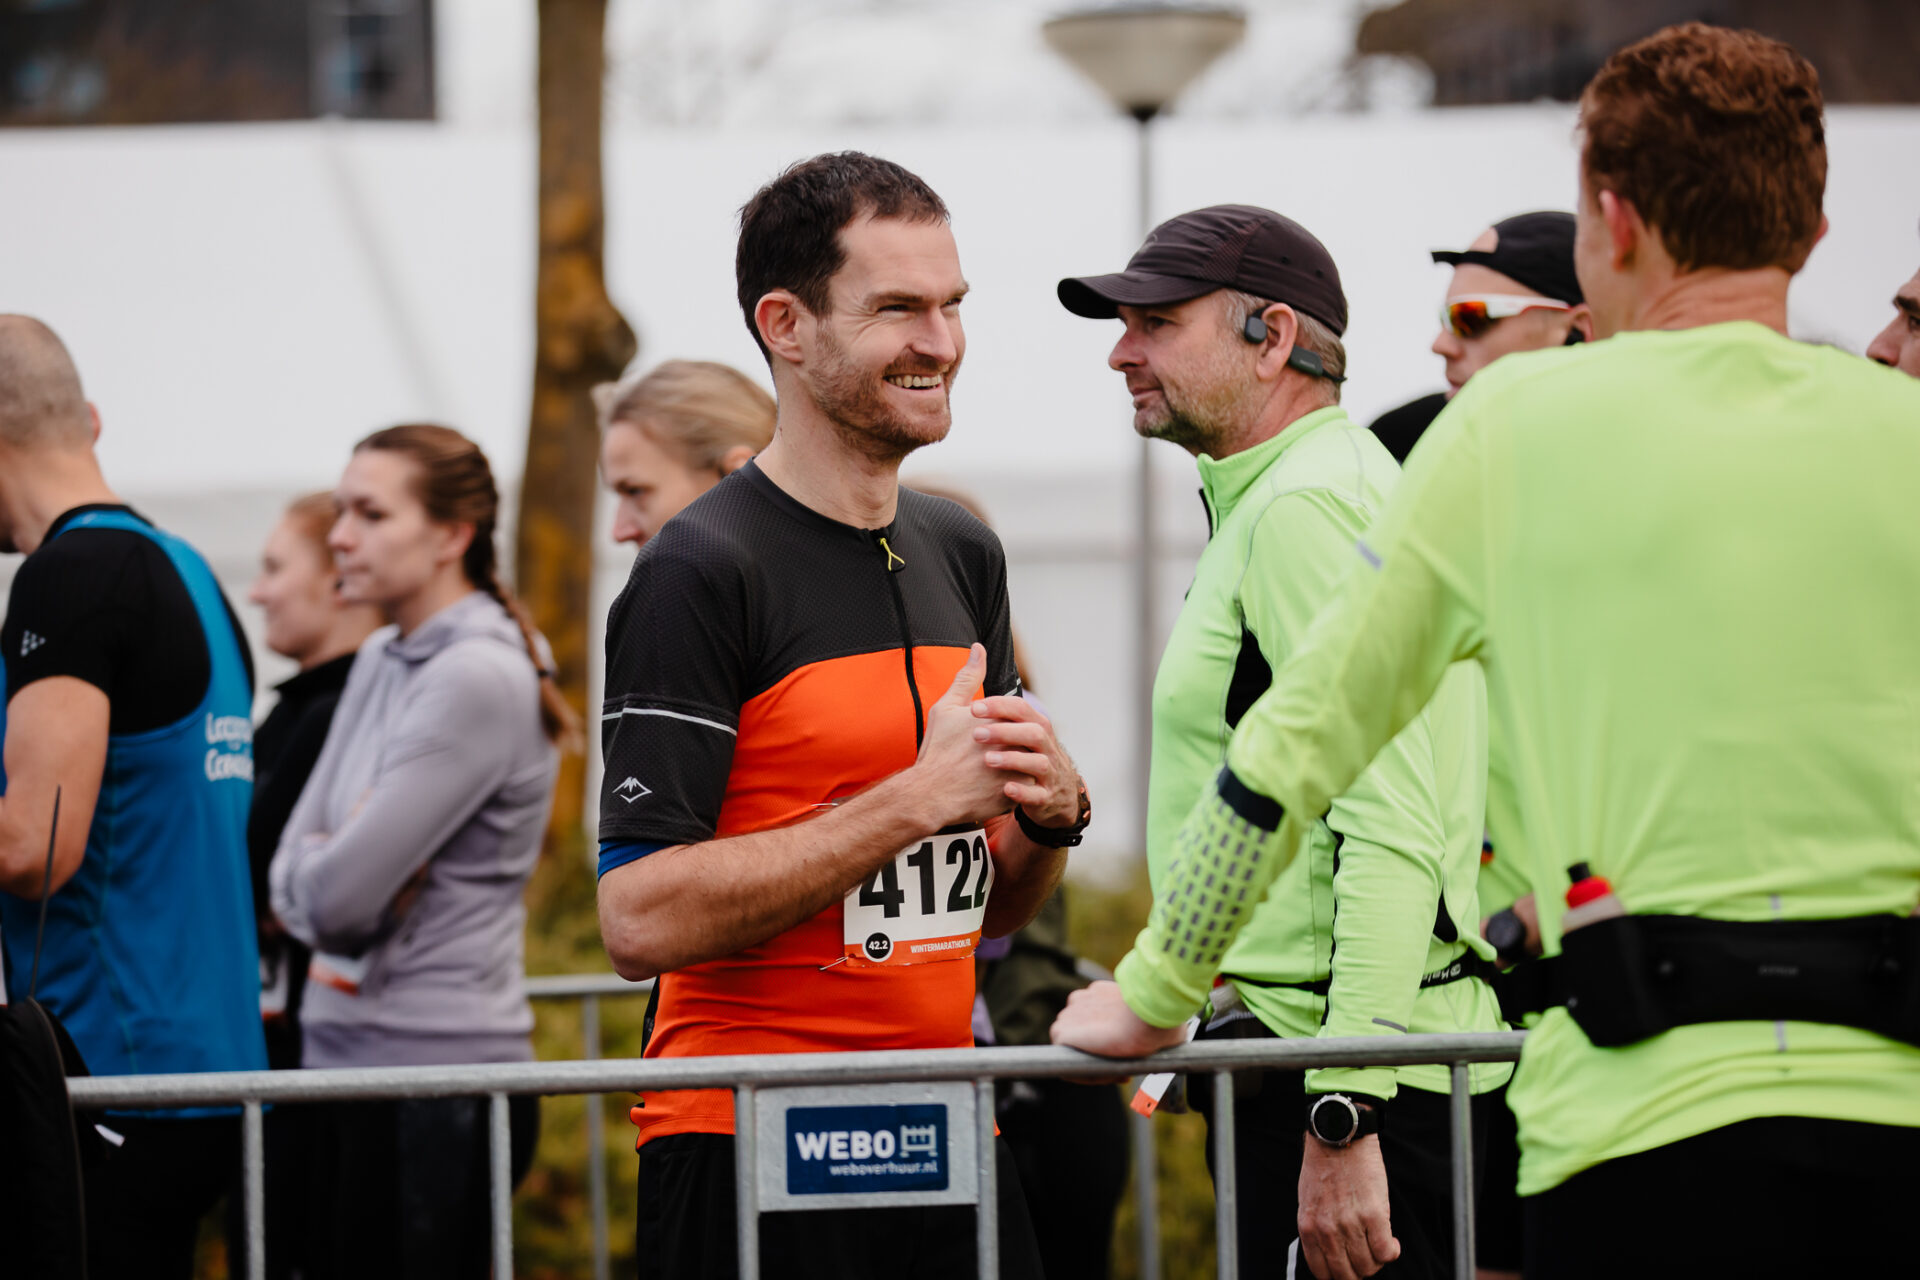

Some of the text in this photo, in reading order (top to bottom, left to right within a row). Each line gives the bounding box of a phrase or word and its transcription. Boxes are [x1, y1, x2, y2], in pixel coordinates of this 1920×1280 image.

[859, 835, 988, 918] 4122
[868, 940, 888, 951] 42.2
[795, 1129, 896, 1161] WEBO
[829, 1160, 938, 1176] weboverhuur.nl
